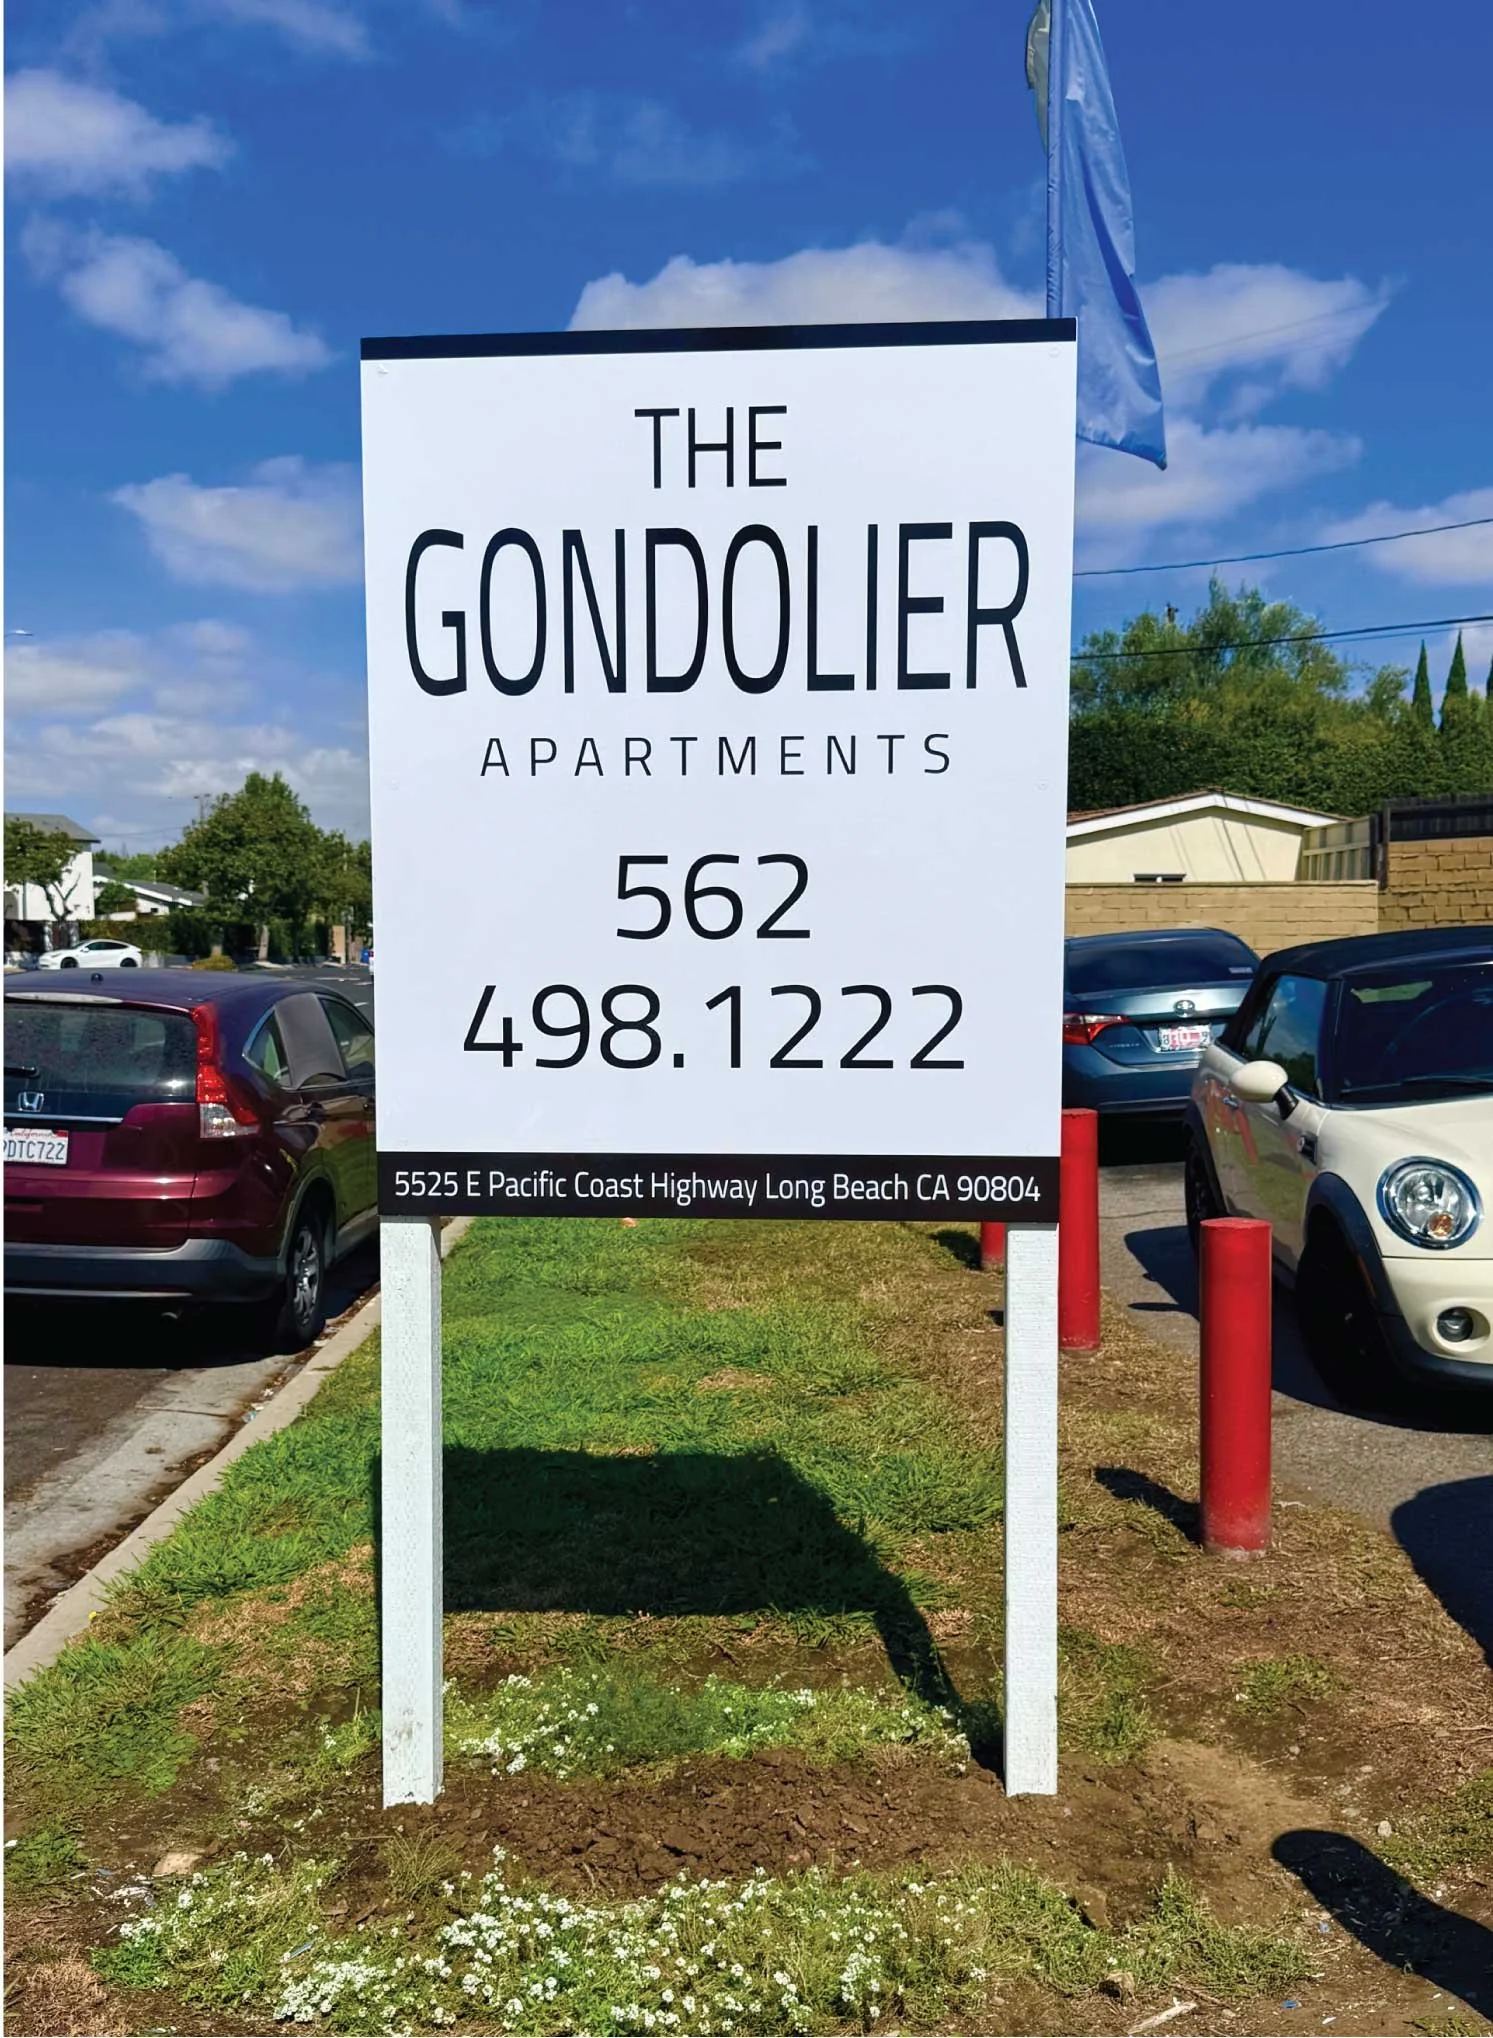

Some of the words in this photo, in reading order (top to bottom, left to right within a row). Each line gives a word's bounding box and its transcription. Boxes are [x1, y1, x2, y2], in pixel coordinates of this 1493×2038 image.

[634, 405, 788, 489] THE
[405, 520, 1030, 697] GONDOLIER
[480, 733, 950, 777] APARTMENTS
[616, 853, 811, 941] 562
[463, 984, 965, 1070] 498.1222
[395, 1171, 459, 1198] 5525
[467, 1170, 481, 1198] E
[489, 1169, 567, 1199] Pacific
[574, 1171, 644, 1200] Coast
[651, 1171, 758, 1207] Highway
[766, 1172, 826, 1208] Long
[833, 1173, 909, 1201] Beach
[916, 1173, 950, 1202] CA
[957, 1175, 1041, 1203] 90804
